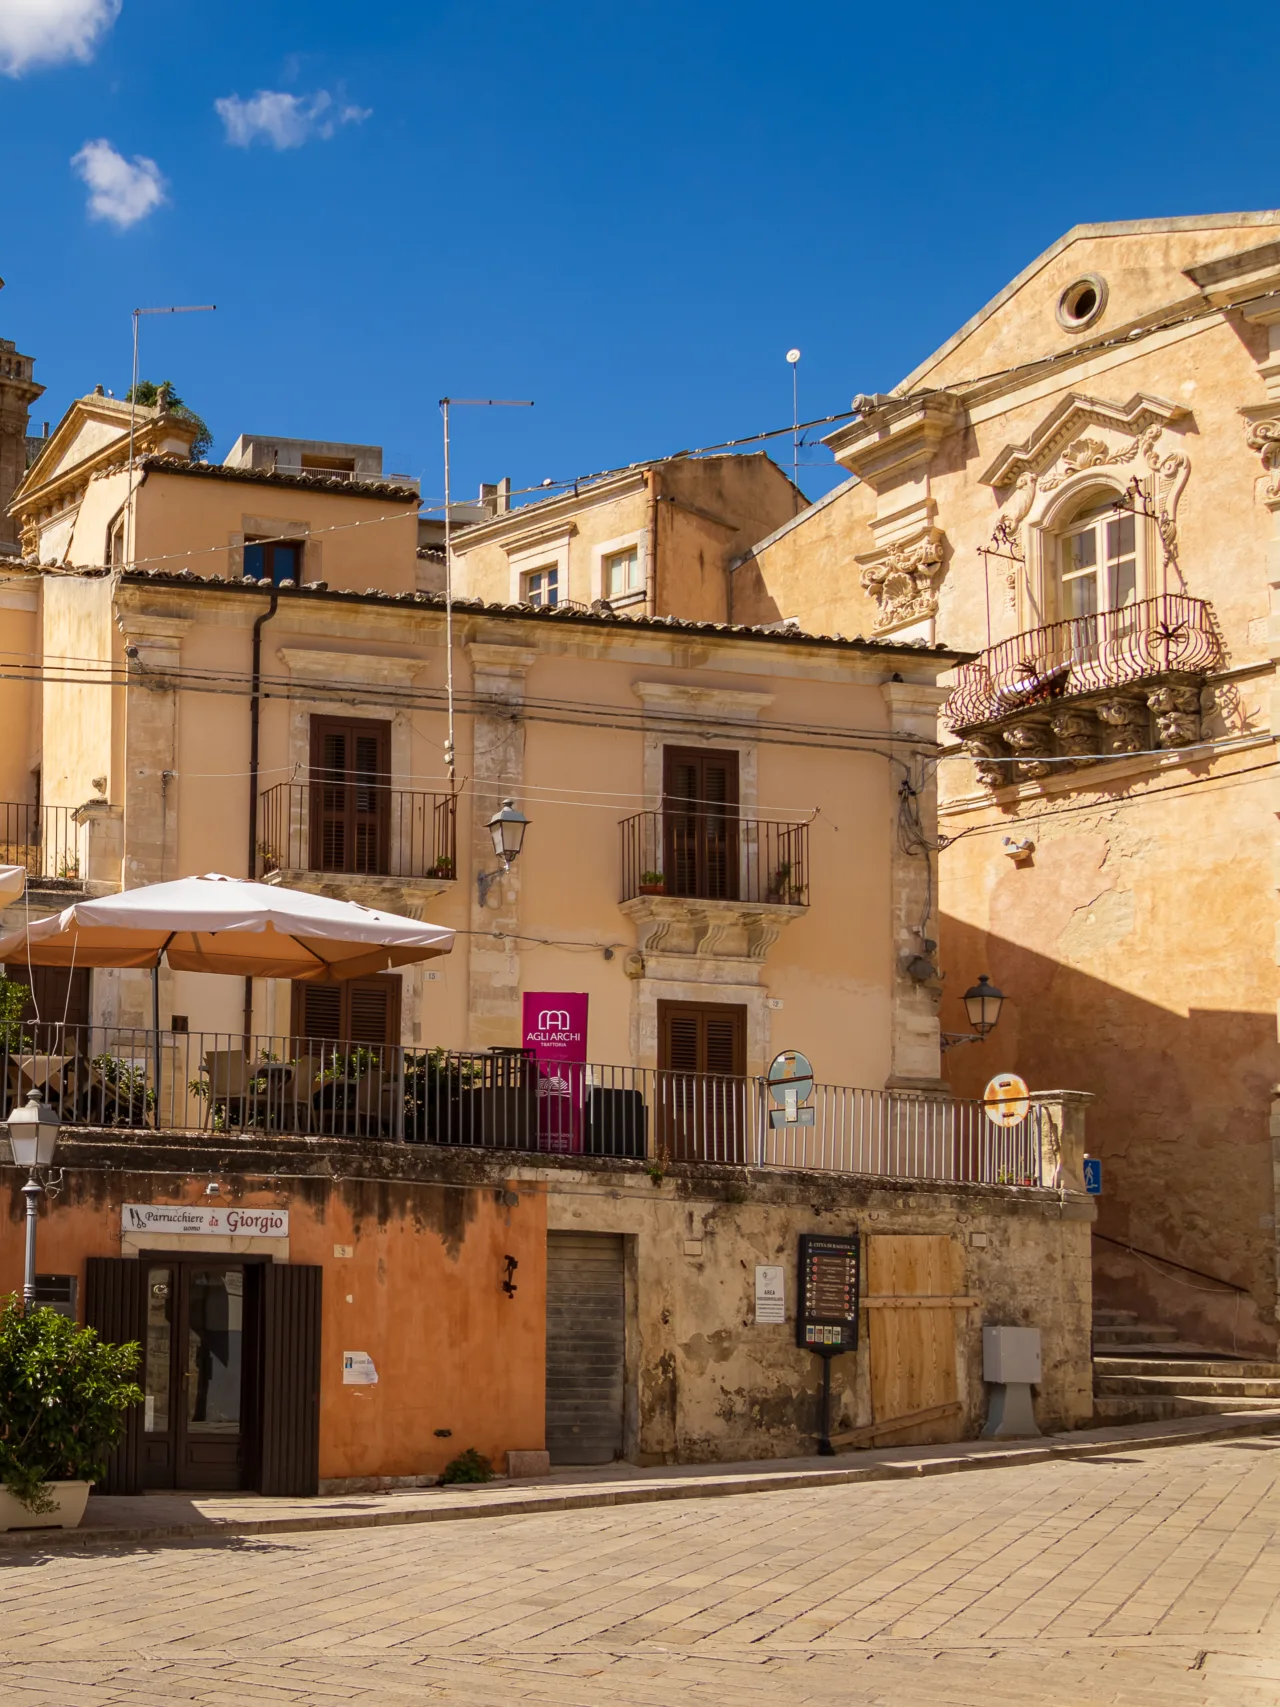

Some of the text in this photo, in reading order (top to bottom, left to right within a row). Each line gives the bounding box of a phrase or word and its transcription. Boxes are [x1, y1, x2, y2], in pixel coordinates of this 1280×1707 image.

[526, 1032, 580, 1041] AGLI ARCHI
[145, 1211, 283, 1233] Parrucchiere da Giorgio
